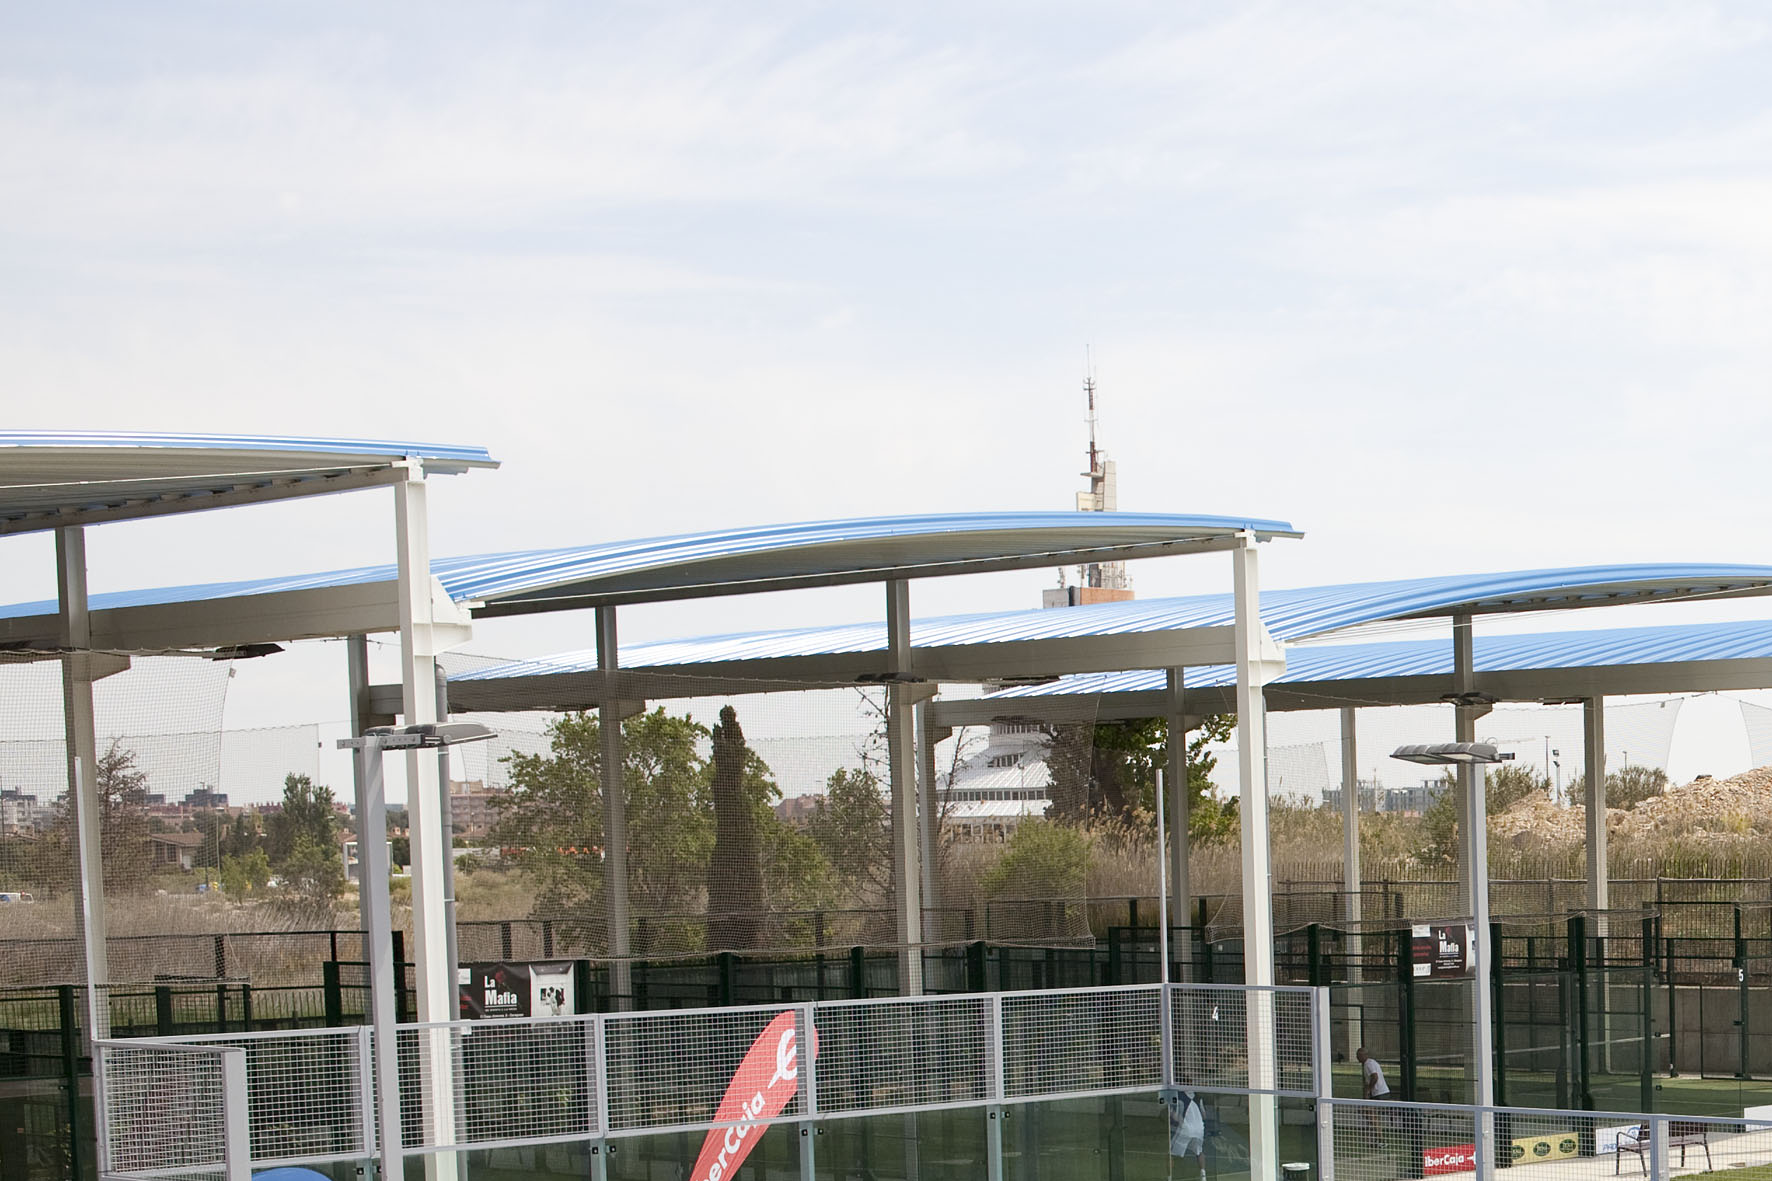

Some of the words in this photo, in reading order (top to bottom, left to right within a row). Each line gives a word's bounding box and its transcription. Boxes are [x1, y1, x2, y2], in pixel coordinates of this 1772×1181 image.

[484, 975, 496, 988] La
[1738, 968, 1744, 982] 5
[484, 989, 518, 1005] Mafia
[1212, 1006, 1218, 1021] 4
